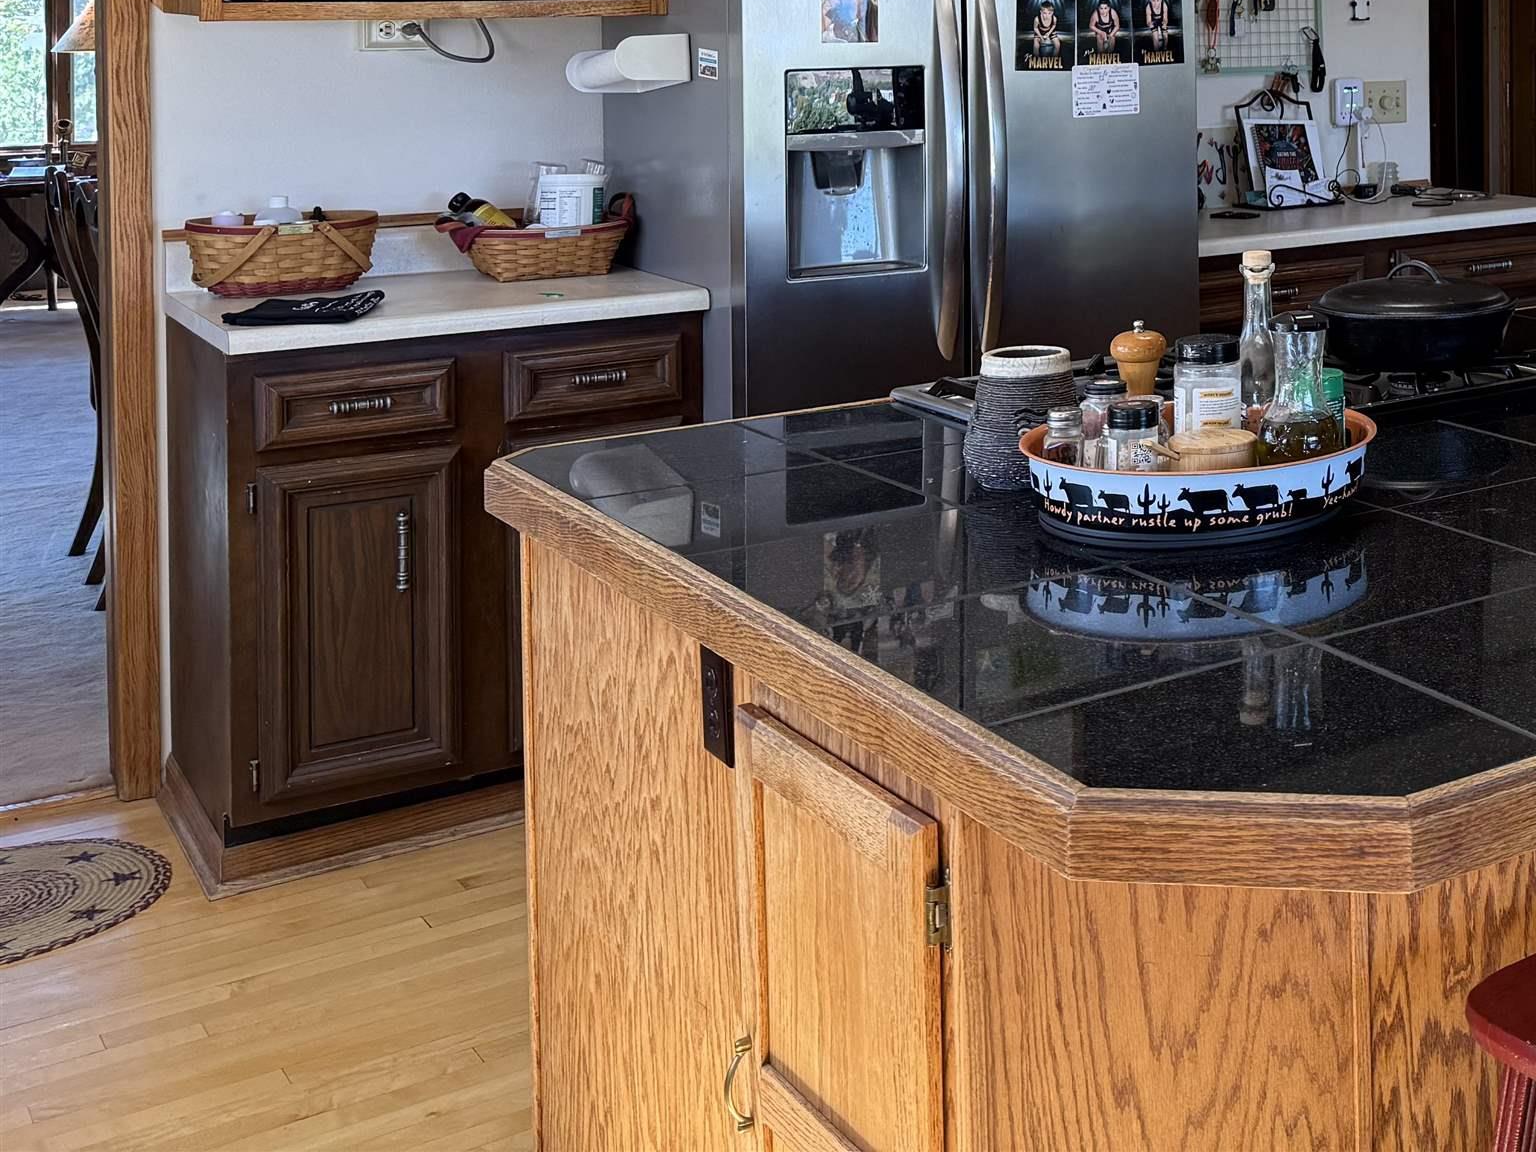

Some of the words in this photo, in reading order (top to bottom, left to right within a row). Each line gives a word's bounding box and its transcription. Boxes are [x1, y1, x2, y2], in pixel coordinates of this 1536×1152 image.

[1028, 56, 1064, 69] MARVEL
[1088, 53, 1122, 65] MARVEL
[1143, 49, 1175, 64] MARVEL
[1043, 497, 1073, 522] Howdy
[1077, 511, 1125, 526] partner
[1131, 512, 1177, 528] rustle
[1184, 518, 1202, 532] up
[1209, 514, 1250, 526] some
[1256, 503, 1293, 527] grub!
